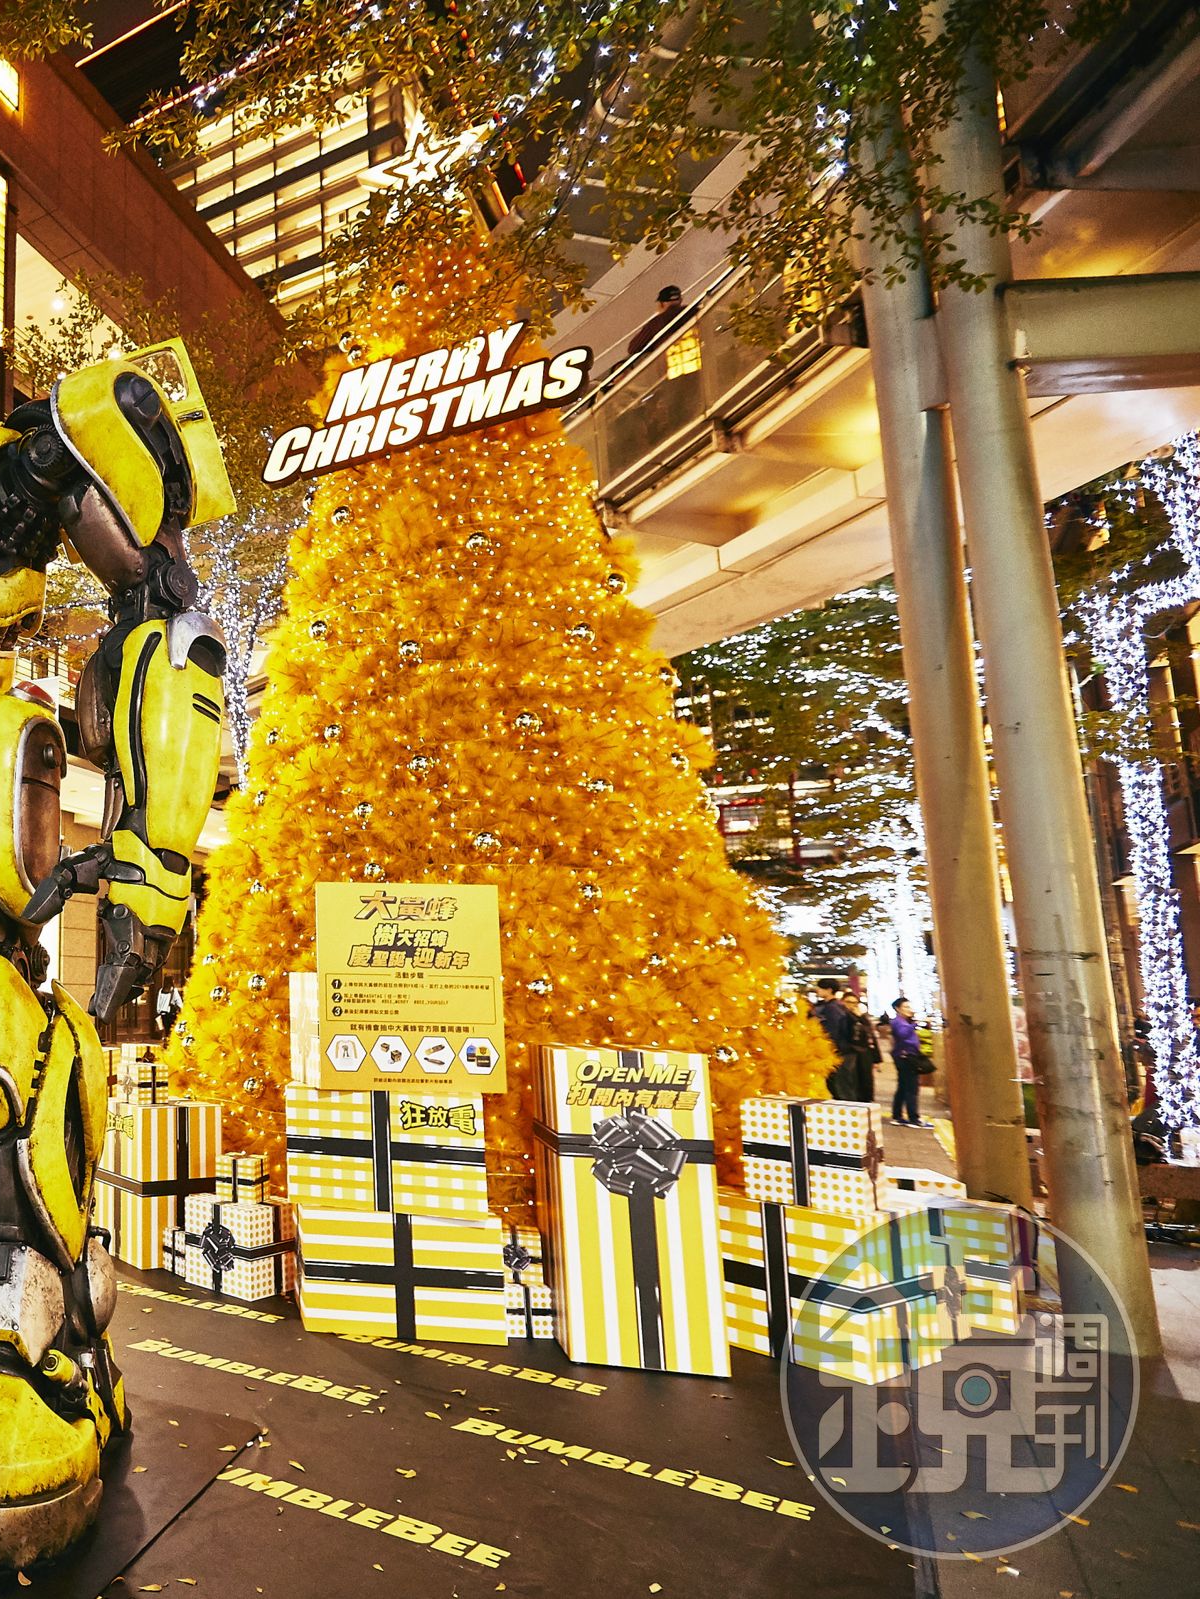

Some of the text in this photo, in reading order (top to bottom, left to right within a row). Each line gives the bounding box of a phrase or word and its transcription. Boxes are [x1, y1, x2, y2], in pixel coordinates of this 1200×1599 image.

[325, 321, 526, 423] MERRY
[262, 348, 589, 483] CHRISTMAS
[354, 890, 458, 921] 大黃蜂
[373, 923, 448, 948] 樹大招蜂
[411, 947, 470, 969] 迎新年
[576, 1060, 696, 1085] OPEN ME!
[566, 1082, 700, 1110] 打開內有驚喜
[400, 1100, 476, 1135] 狂放電
[116, 1281, 285, 1323] UMBLEBEE
[126, 1339, 379, 1406] BUMBLEBEE
[338, 1334, 607, 1396] BUMBLEBEE
[450, 1418, 815, 1521] BUMBLEBEE
[216, 1468, 511, 1568] UMBLEBEE
